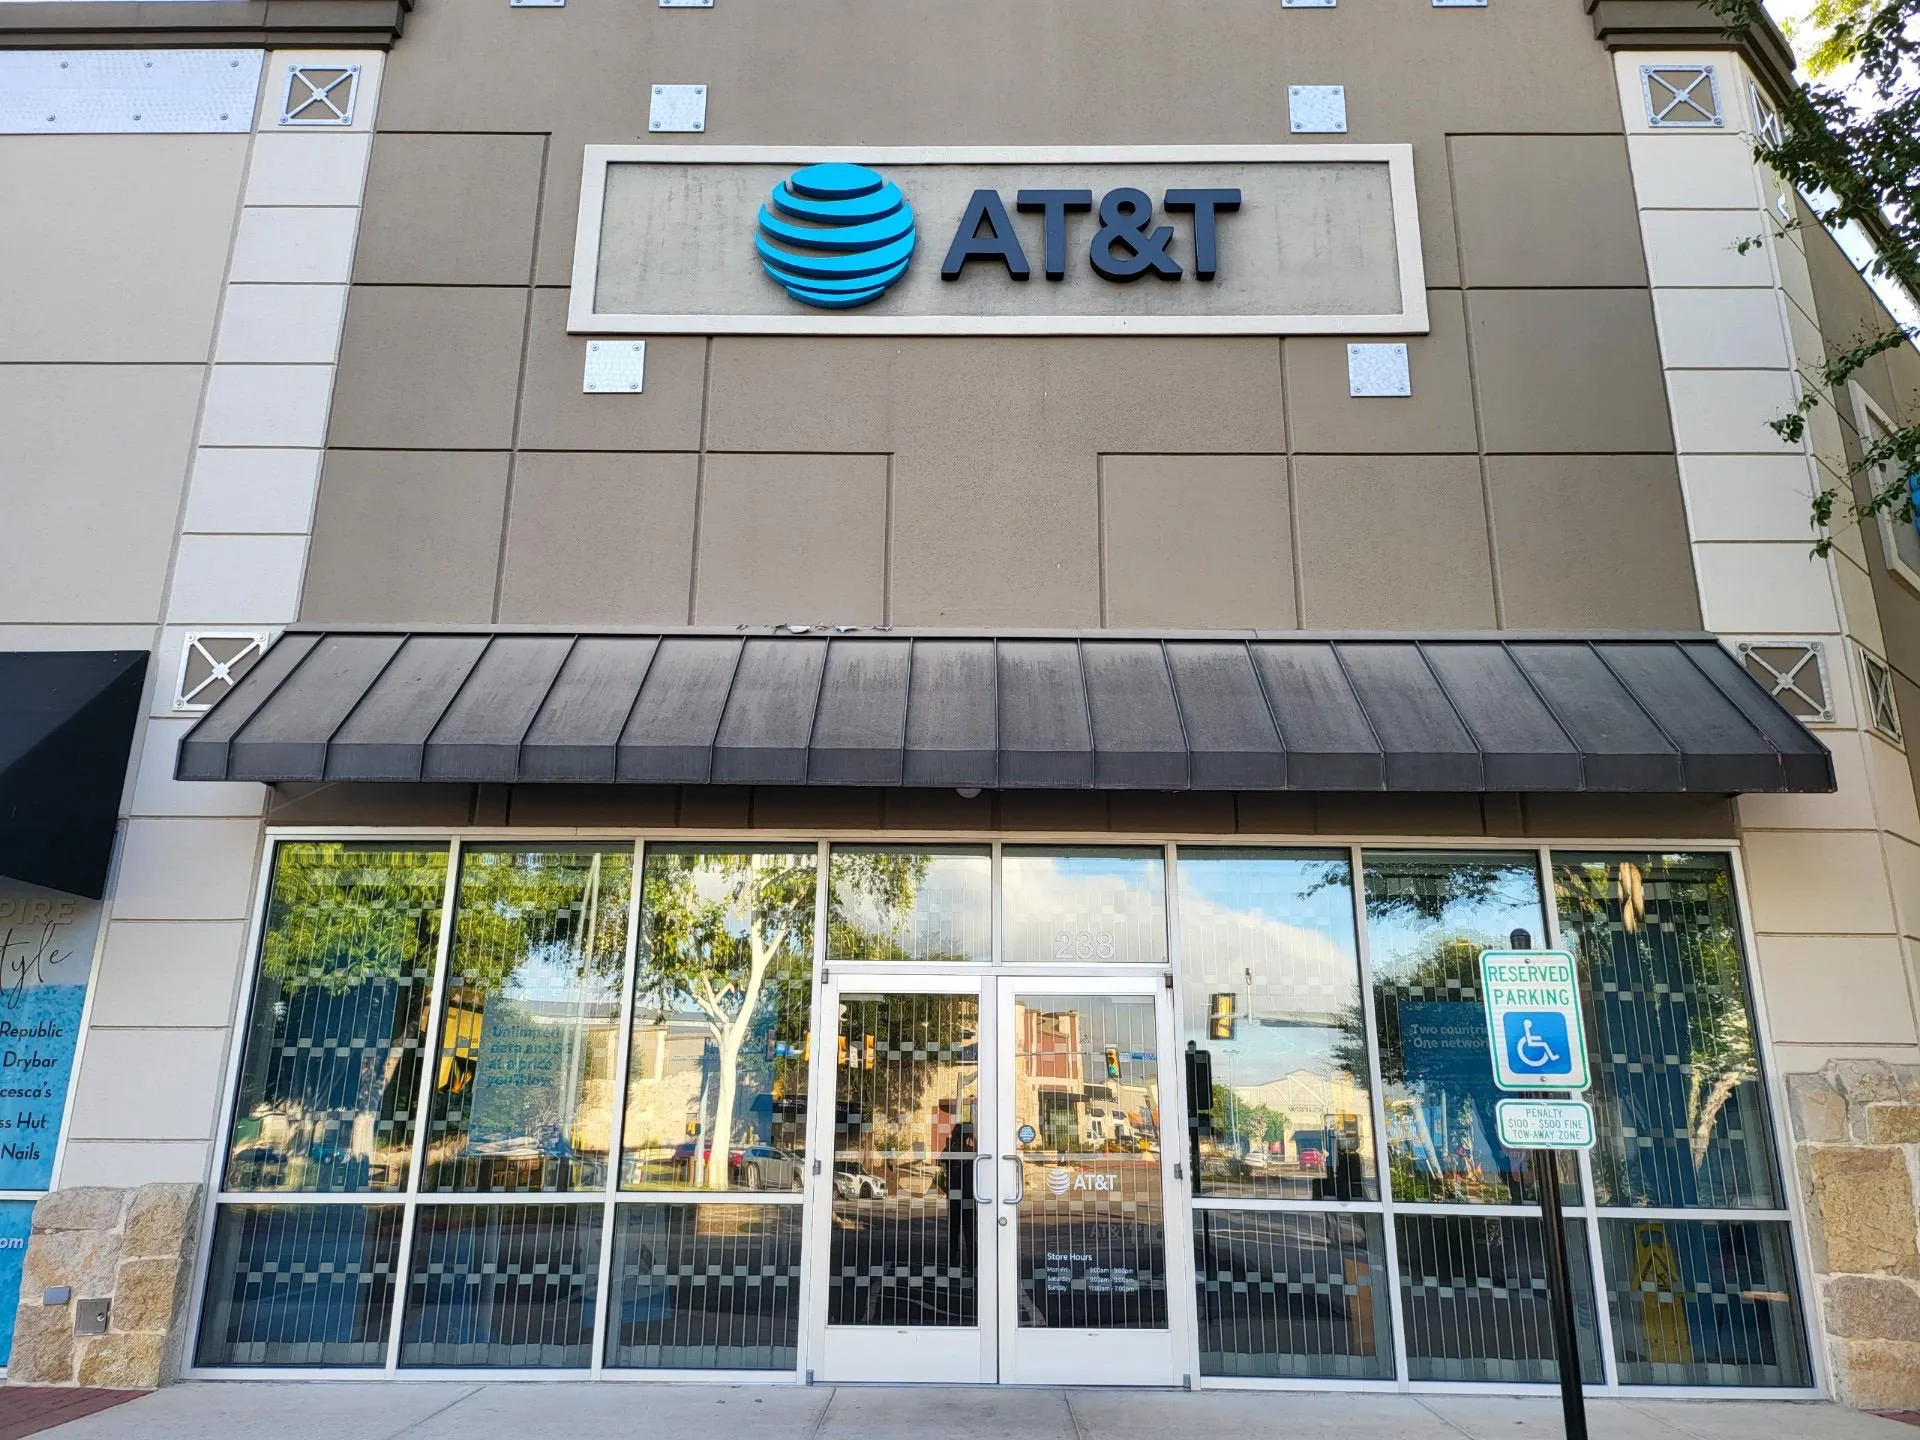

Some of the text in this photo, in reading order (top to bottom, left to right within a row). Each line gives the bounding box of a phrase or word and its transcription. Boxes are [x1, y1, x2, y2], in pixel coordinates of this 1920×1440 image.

[941, 188, 1241, 283] AT&T
[1487, 966, 1569, 982] RESERVED
[1494, 989, 1569, 1005] PARKING
[0, 1021, 64, 1041] Republic
[1410, 1024, 1438, 1034] Two
[1414, 1038, 1438, 1048] One
[3, 1051, 58, 1072] Drybar
[0, 1081, 52, 1098] cesca's
[17, 1111, 47, 1128] Hut
[1526, 1109, 1563, 1117] PENALTY
[1509, 1120, 1528, 1128] $100
[1539, 1121, 1560, 1129] $500
[1565, 1120, 1584, 1129] FINE
[1513, 1130, 1581, 1139] TOW-AWAY ZONE
[1, 1142, 41, 1160] Nails
[1074, 1174, 1118, 1191] AT&T
[1047, 1252, 1093, 1261] Store Hours
